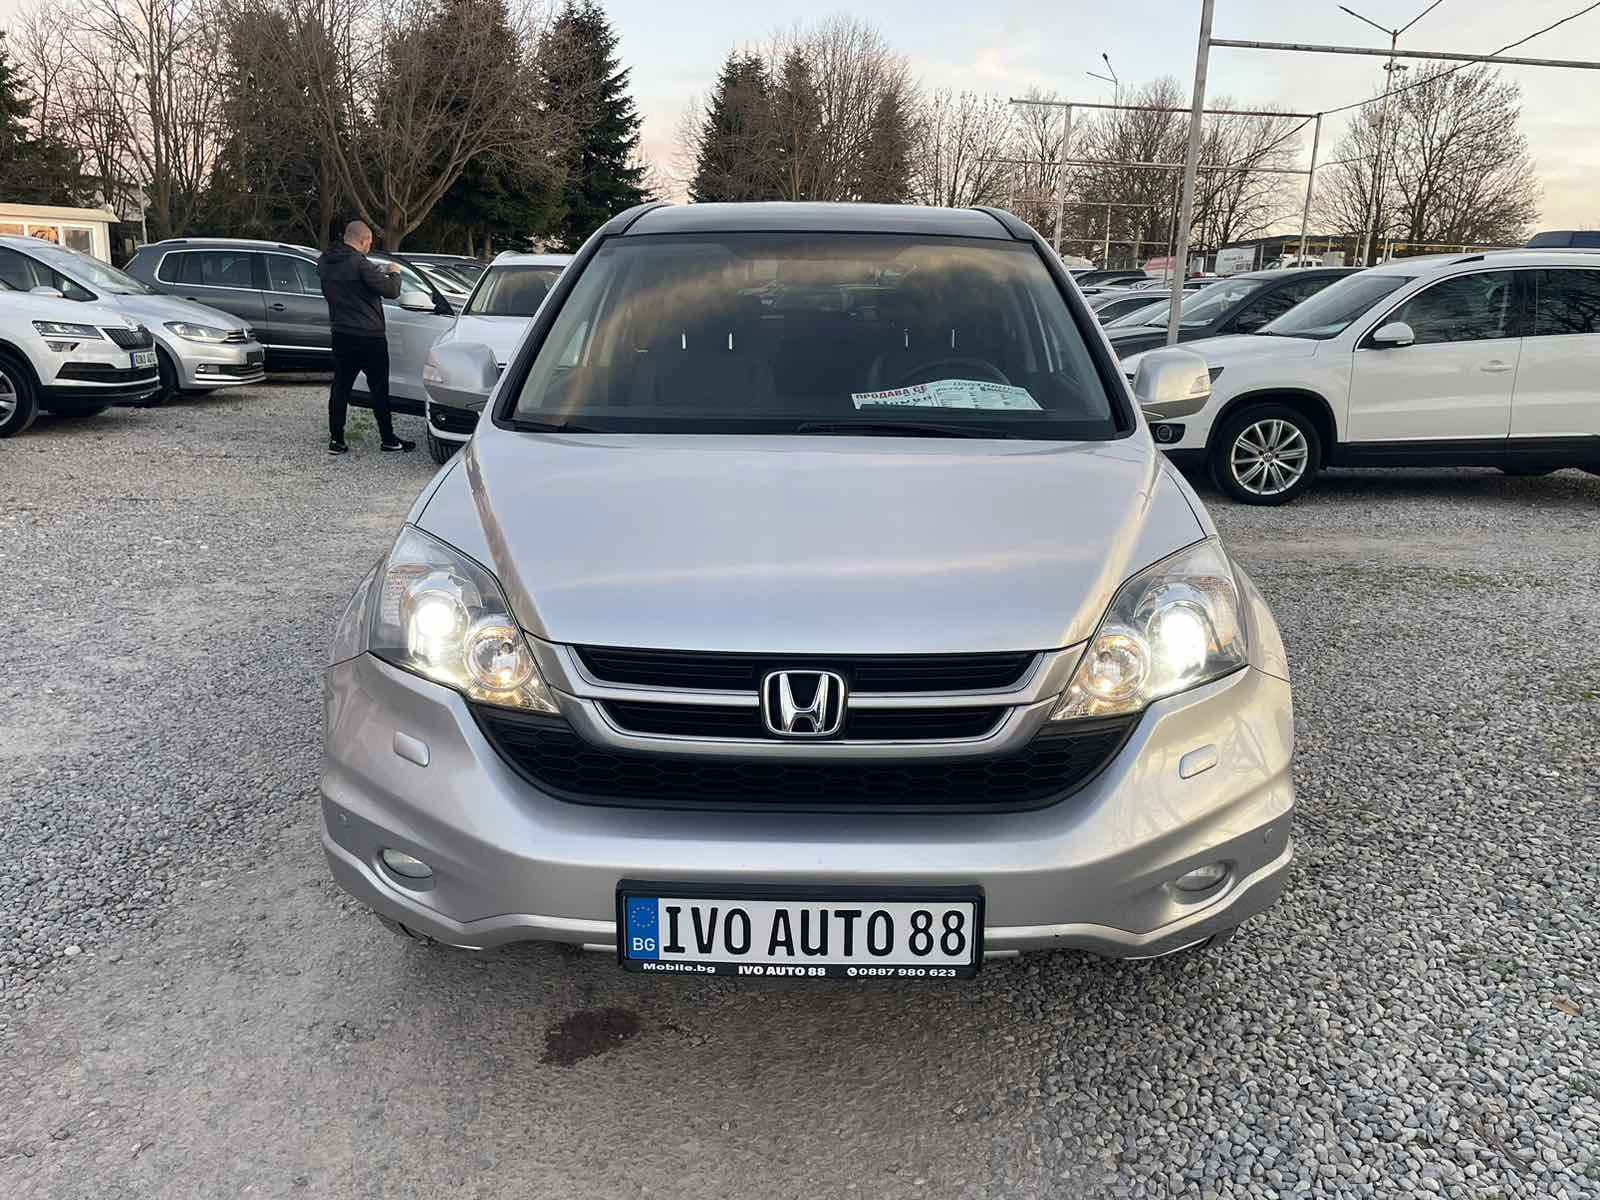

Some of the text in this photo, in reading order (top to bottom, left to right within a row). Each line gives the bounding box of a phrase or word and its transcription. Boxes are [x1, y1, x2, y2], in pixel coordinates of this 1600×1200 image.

[855, 388, 910, 399] ПРОДАВА
[913, 384, 928, 393] СЕ
[663, 905, 966, 957] IVO AUTO 88
[632, 937, 656, 952] BG
[642, 962, 716, 974] Mobile.bg
[738, 965, 826, 977] IVO AUTO 88
[858, 967, 957, 977] 0887 980 623
